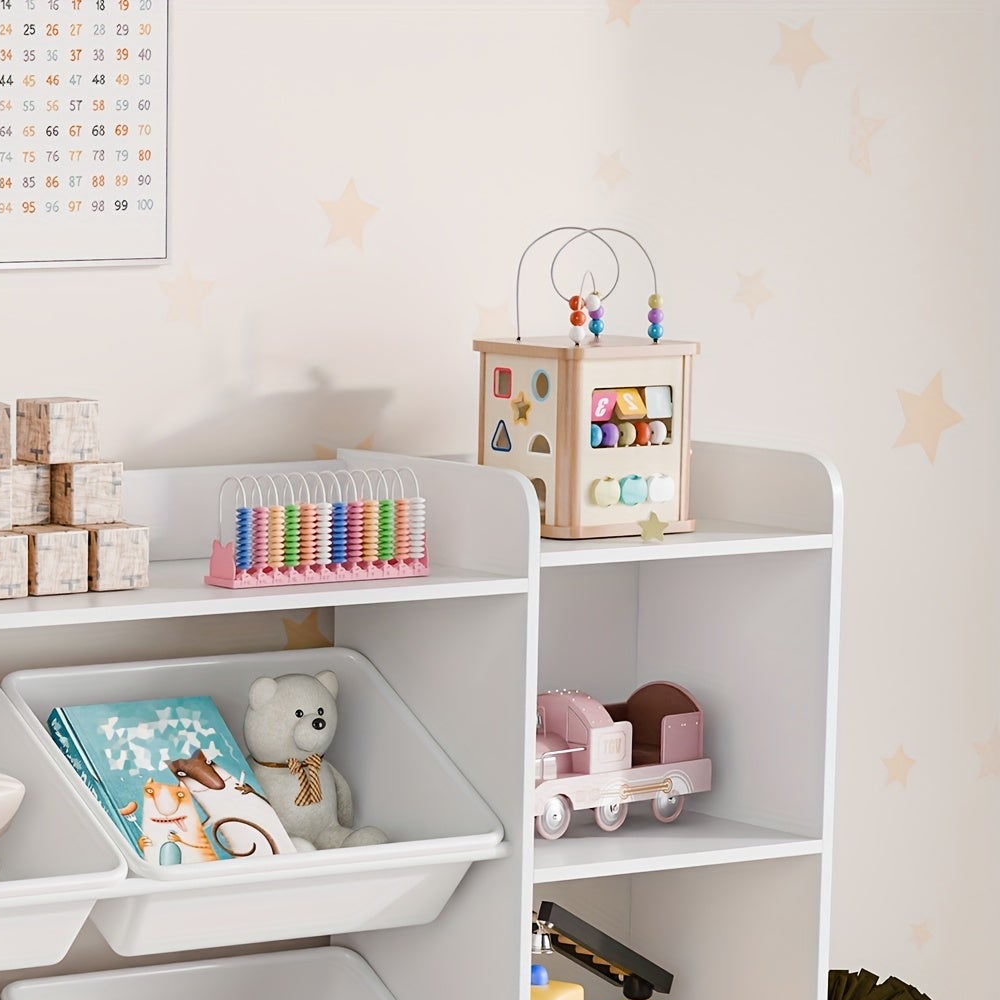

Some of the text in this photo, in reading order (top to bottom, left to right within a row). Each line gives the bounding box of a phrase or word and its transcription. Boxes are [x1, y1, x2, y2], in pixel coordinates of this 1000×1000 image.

[0, 0, 12, 10] 14
[24, 0, 36, 11] 15
[47, 0, 60, 11] 16
[71, 0, 83, 11] 17
[95, 0, 106, 12] 18
[118, 0, 130, 12] 19
[139, 0, 153, 11] 20
[0, 23, 13, 37] 24
[23, 23, 36, 36] 25
[45, 23, 59, 37] 26
[69, 23, 83, 37] 27
[93, 23, 106, 36] 28
[116, 23, 130, 36] 29
[138, 23, 152, 36] 30
[0, 48, 13, 62] 34
[23, 49, 36, 63] 35
[46, 49, 59, 62] 36
[70, 48, 83, 62] 37
[92, 48, 105, 62] 38
[116, 47, 129, 61] 39
[137, 48, 152, 61] 40
[22, 74, 37, 88] 45
[45, 74, 60, 87] 46
[69, 74, 83, 86] 47
[91, 74, 106, 85] 48
[115, 73, 130, 86] 49
[138, 74, 152, 86] 50
[0, 99, 13, 112] 54
[22, 100, 36, 112] 55
[46, 99, 60, 113] 56
[69, 99, 83, 112] 57
[92, 99, 106, 112] 58
[115, 99, 130, 112] 59
[137, 98, 151, 112] 60
[0, 125, 13, 138] 64
[22, 125, 36, 138] 65
[45, 125, 59, 137] 66
[68, 124, 83, 138] 67
[91, 124, 106, 137] 68
[114, 124, 129, 137] 69
[137, 123, 152, 137] 70
[21, 150, 36, 164] 75
[46, 150, 60, 163] 76
[68, 149, 83, 162] 77
[92, 149, 105, 162] 78
[115, 149, 129, 162] 79
[138, 149, 152, 162] 80
[22, 175, 36, 189] 85
[45, 175, 60, 189] 86
[68, 175, 83, 188] 87
[91, 174, 106, 188] 88
[114, 174, 129, 187] 89
[137, 174, 152, 186] 90
[21, 200, 37, 214] 95
[44, 200, 60, 213] 96
[67, 200, 83, 213] 97
[91, 199, 105, 213] 98
[114, 199, 129, 211] 99
[136, 198, 154, 211] 100
